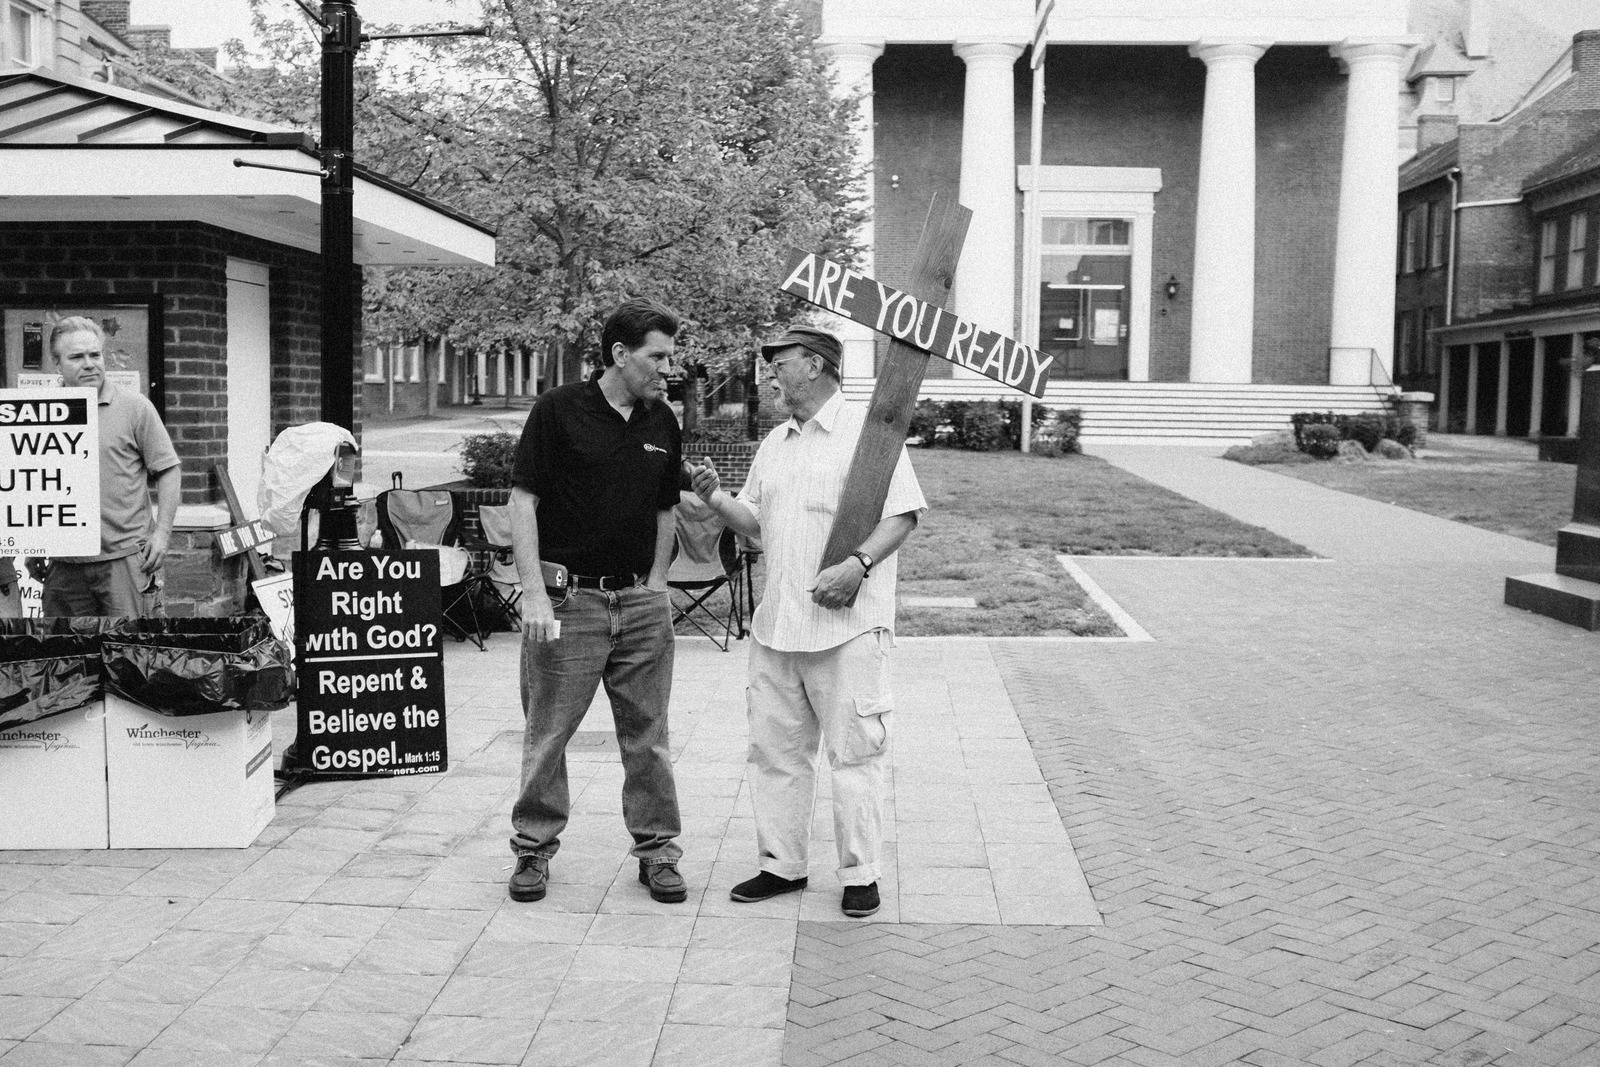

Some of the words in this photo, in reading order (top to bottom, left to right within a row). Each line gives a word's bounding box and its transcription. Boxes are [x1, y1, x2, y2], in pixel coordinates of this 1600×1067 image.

[780, 252, 863, 317] ARE
[876, 281, 943, 350] YOU
[946, 315, 1054, 395] READY
[0, 402, 69, 423] SAID
[10, 431, 89, 459] WAY,
[7, 504, 87, 527] LIFE.
[316, 556, 364, 580] Are
[371, 555, 421, 579] You
[331, 590, 403, 621] Right
[305, 626, 357, 651] with
[366, 623, 437, 650] God?
[319, 667, 404, 699] Repent
[410, 665, 427, 690] &
[126, 723, 202, 739] Winchester
[309, 708, 396, 734] Believe
[403, 704, 440, 729] the
[312, 741, 402, 773] Gospel.
[404, 752, 423, 764] Mark
[424, 750, 440, 762] 1:15
